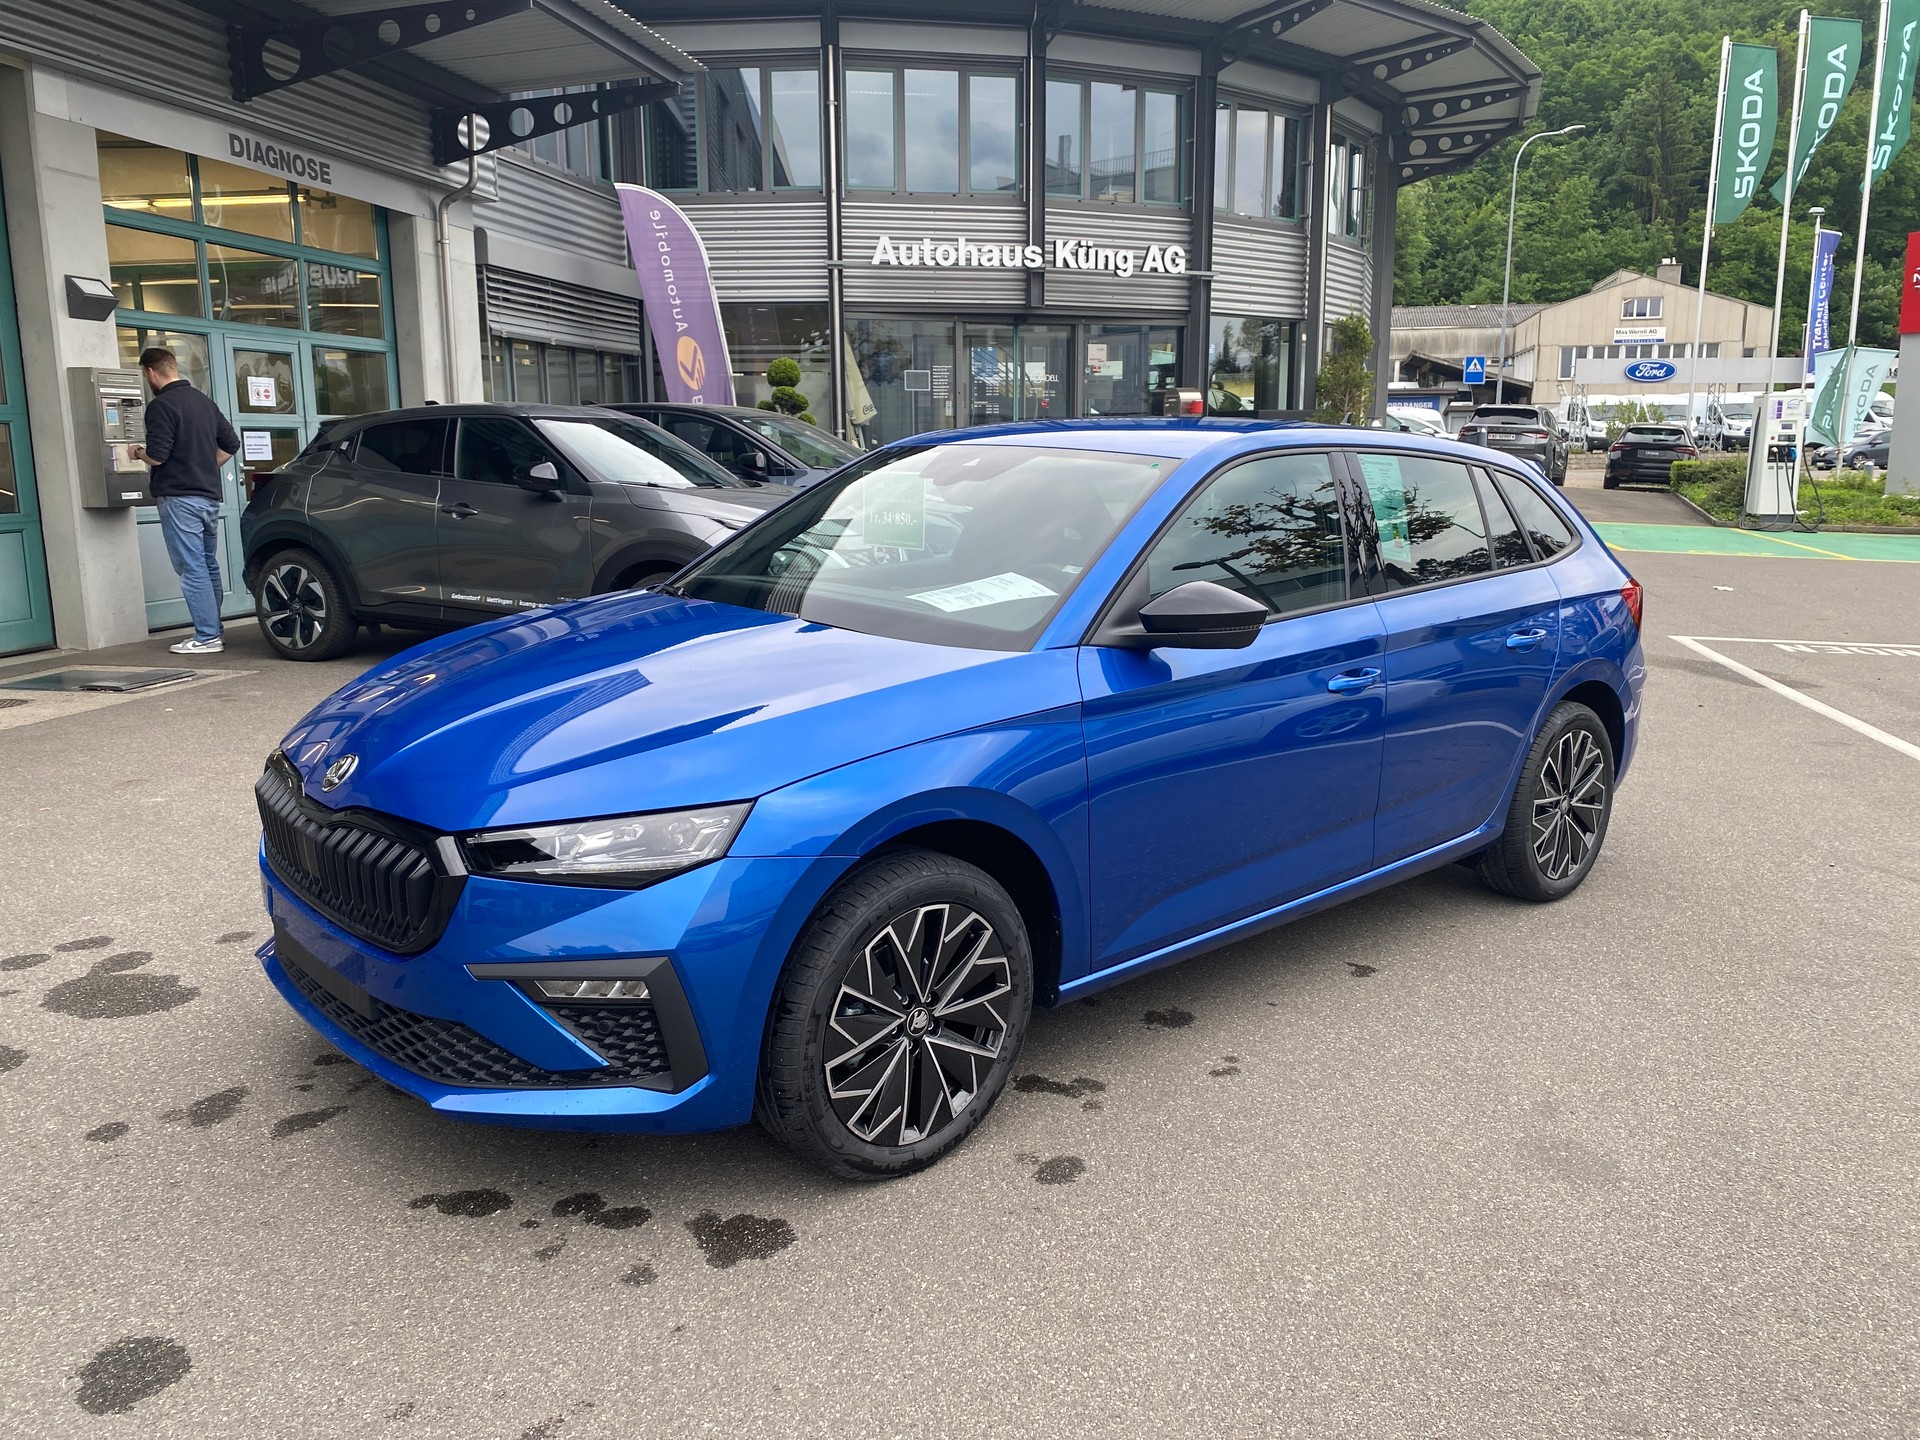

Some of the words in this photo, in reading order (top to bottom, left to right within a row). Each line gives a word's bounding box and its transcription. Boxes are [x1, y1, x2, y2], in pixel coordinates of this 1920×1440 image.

[229, 133, 332, 185] DIAGNOSE
[871, 235, 1044, 268] Autohaus
[1054, 239, 1134, 278] Küng
[1142, 244, 1186, 274] AG
[1813, 300, 1826, 349] Transit
[1635, 363, 1668, 377] Ford
[451, 593, 481, 601] Gebenstorf
